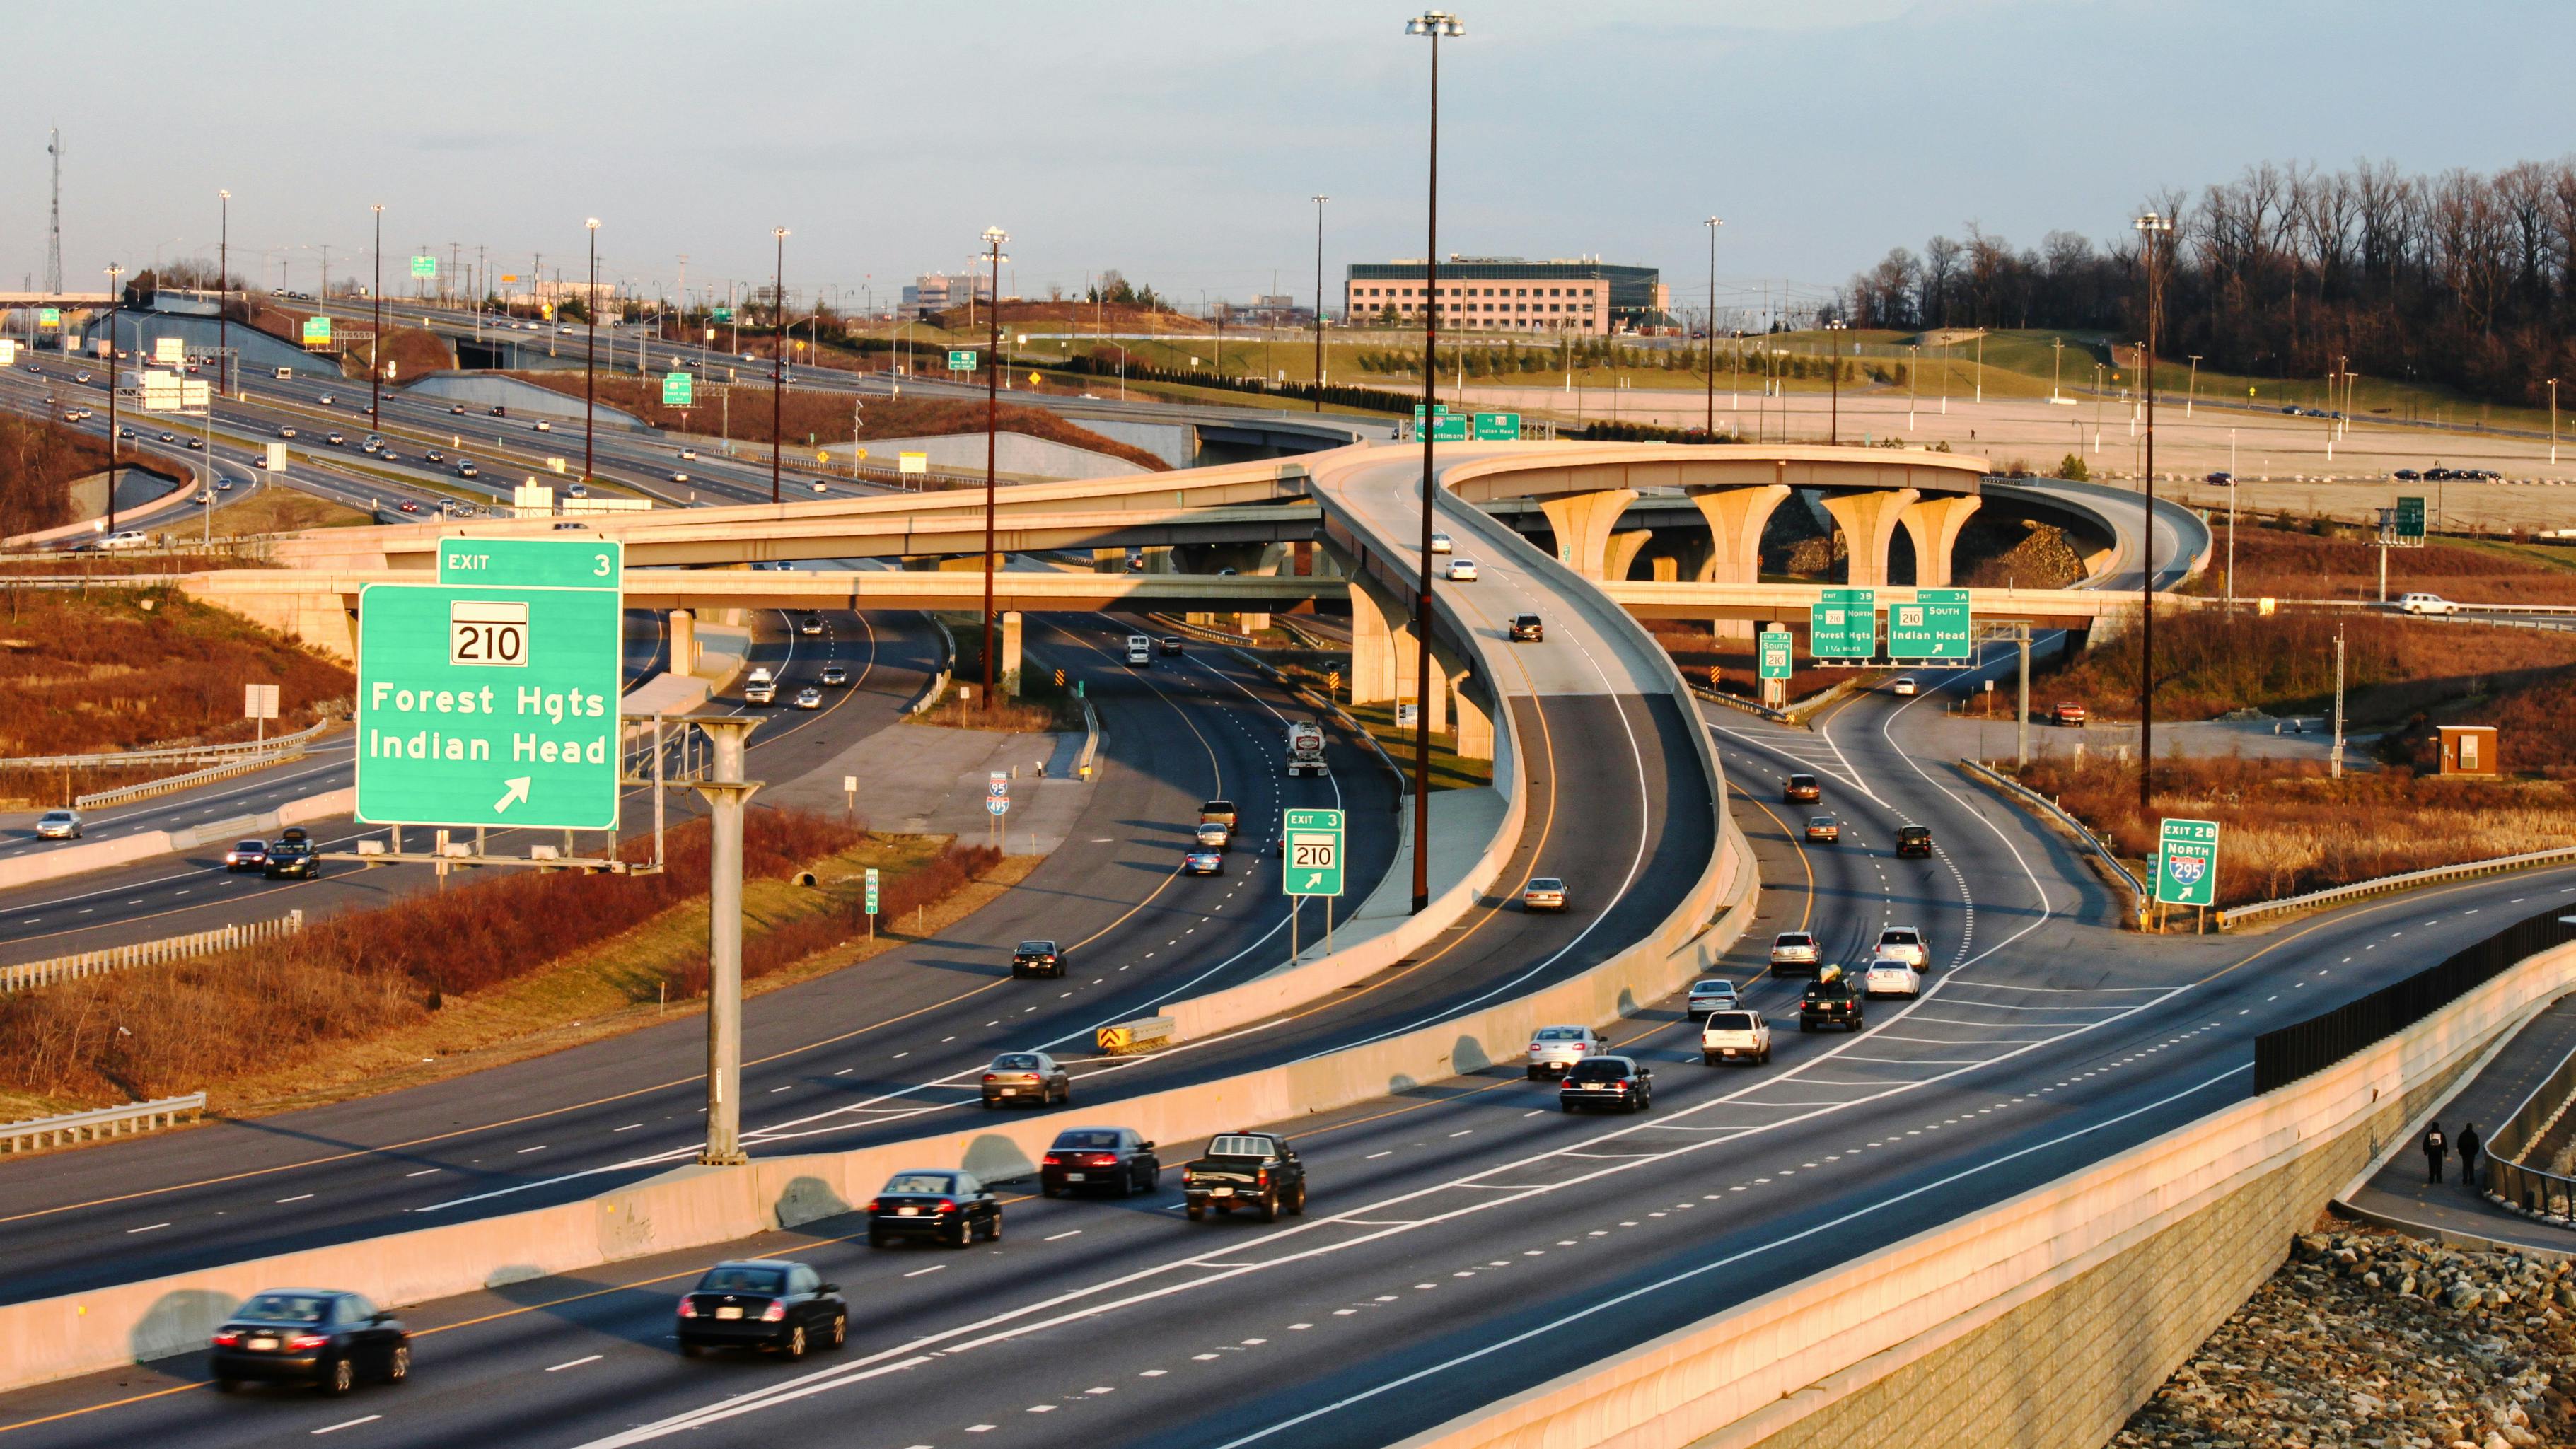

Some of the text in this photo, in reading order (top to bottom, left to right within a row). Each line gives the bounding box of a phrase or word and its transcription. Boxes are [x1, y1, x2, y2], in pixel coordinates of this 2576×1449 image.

[448, 554, 610, 576] EXIT 3
[1929, 607, 1960, 615] SOUTH
[1903, 614, 1920, 624] 210
[1849, 632, 1871, 641] Hgts
[1893, 630, 1966, 640] Indian Head
[458, 626, 520, 661] 210
[1768, 656, 1783, 665] 210
[372, 682, 605, 725] Forest Hgts
[370, 728, 605, 764] Indian Head
[992, 783, 1005, 793] 95
[990, 801, 1006, 812] 495
[1291, 814, 1338, 826] EXIT 3
[2164, 825, 2215, 838] EXIT 2B
[1297, 846, 1331, 865] 210
[2167, 843, 2209, 856] NORTH
[2174, 863, 2201, 879] 295
